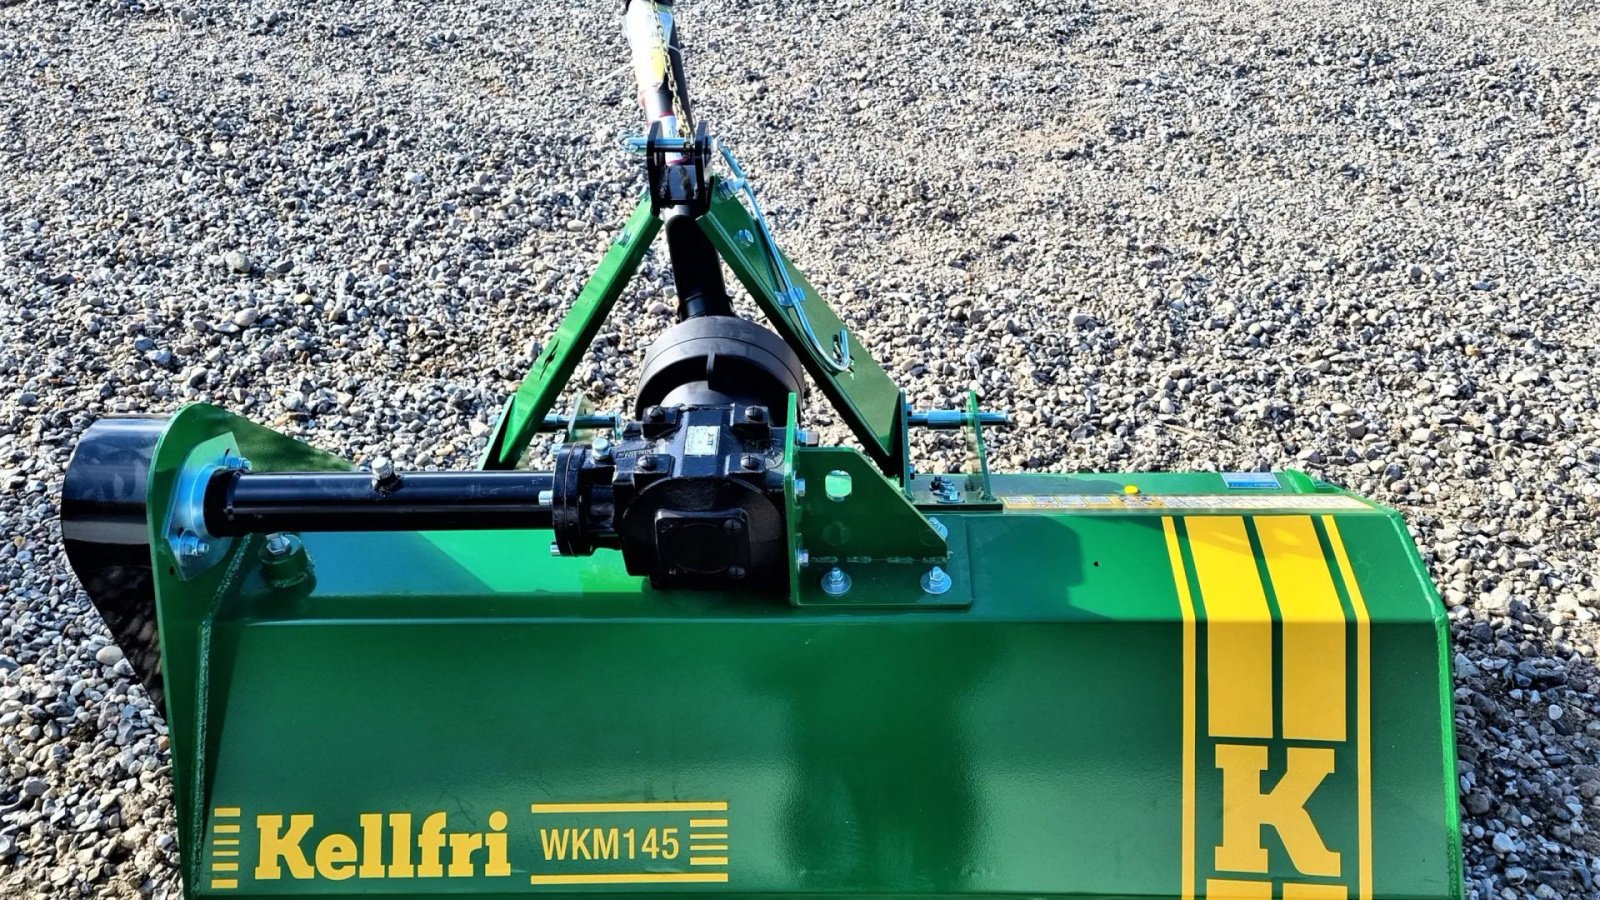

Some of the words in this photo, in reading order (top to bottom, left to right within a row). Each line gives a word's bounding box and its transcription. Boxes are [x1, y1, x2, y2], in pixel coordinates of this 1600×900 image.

[254, 810, 511, 880] Kellfri
[540, 828, 680, 859] WKM145
[1214, 743, 1342, 878] K
